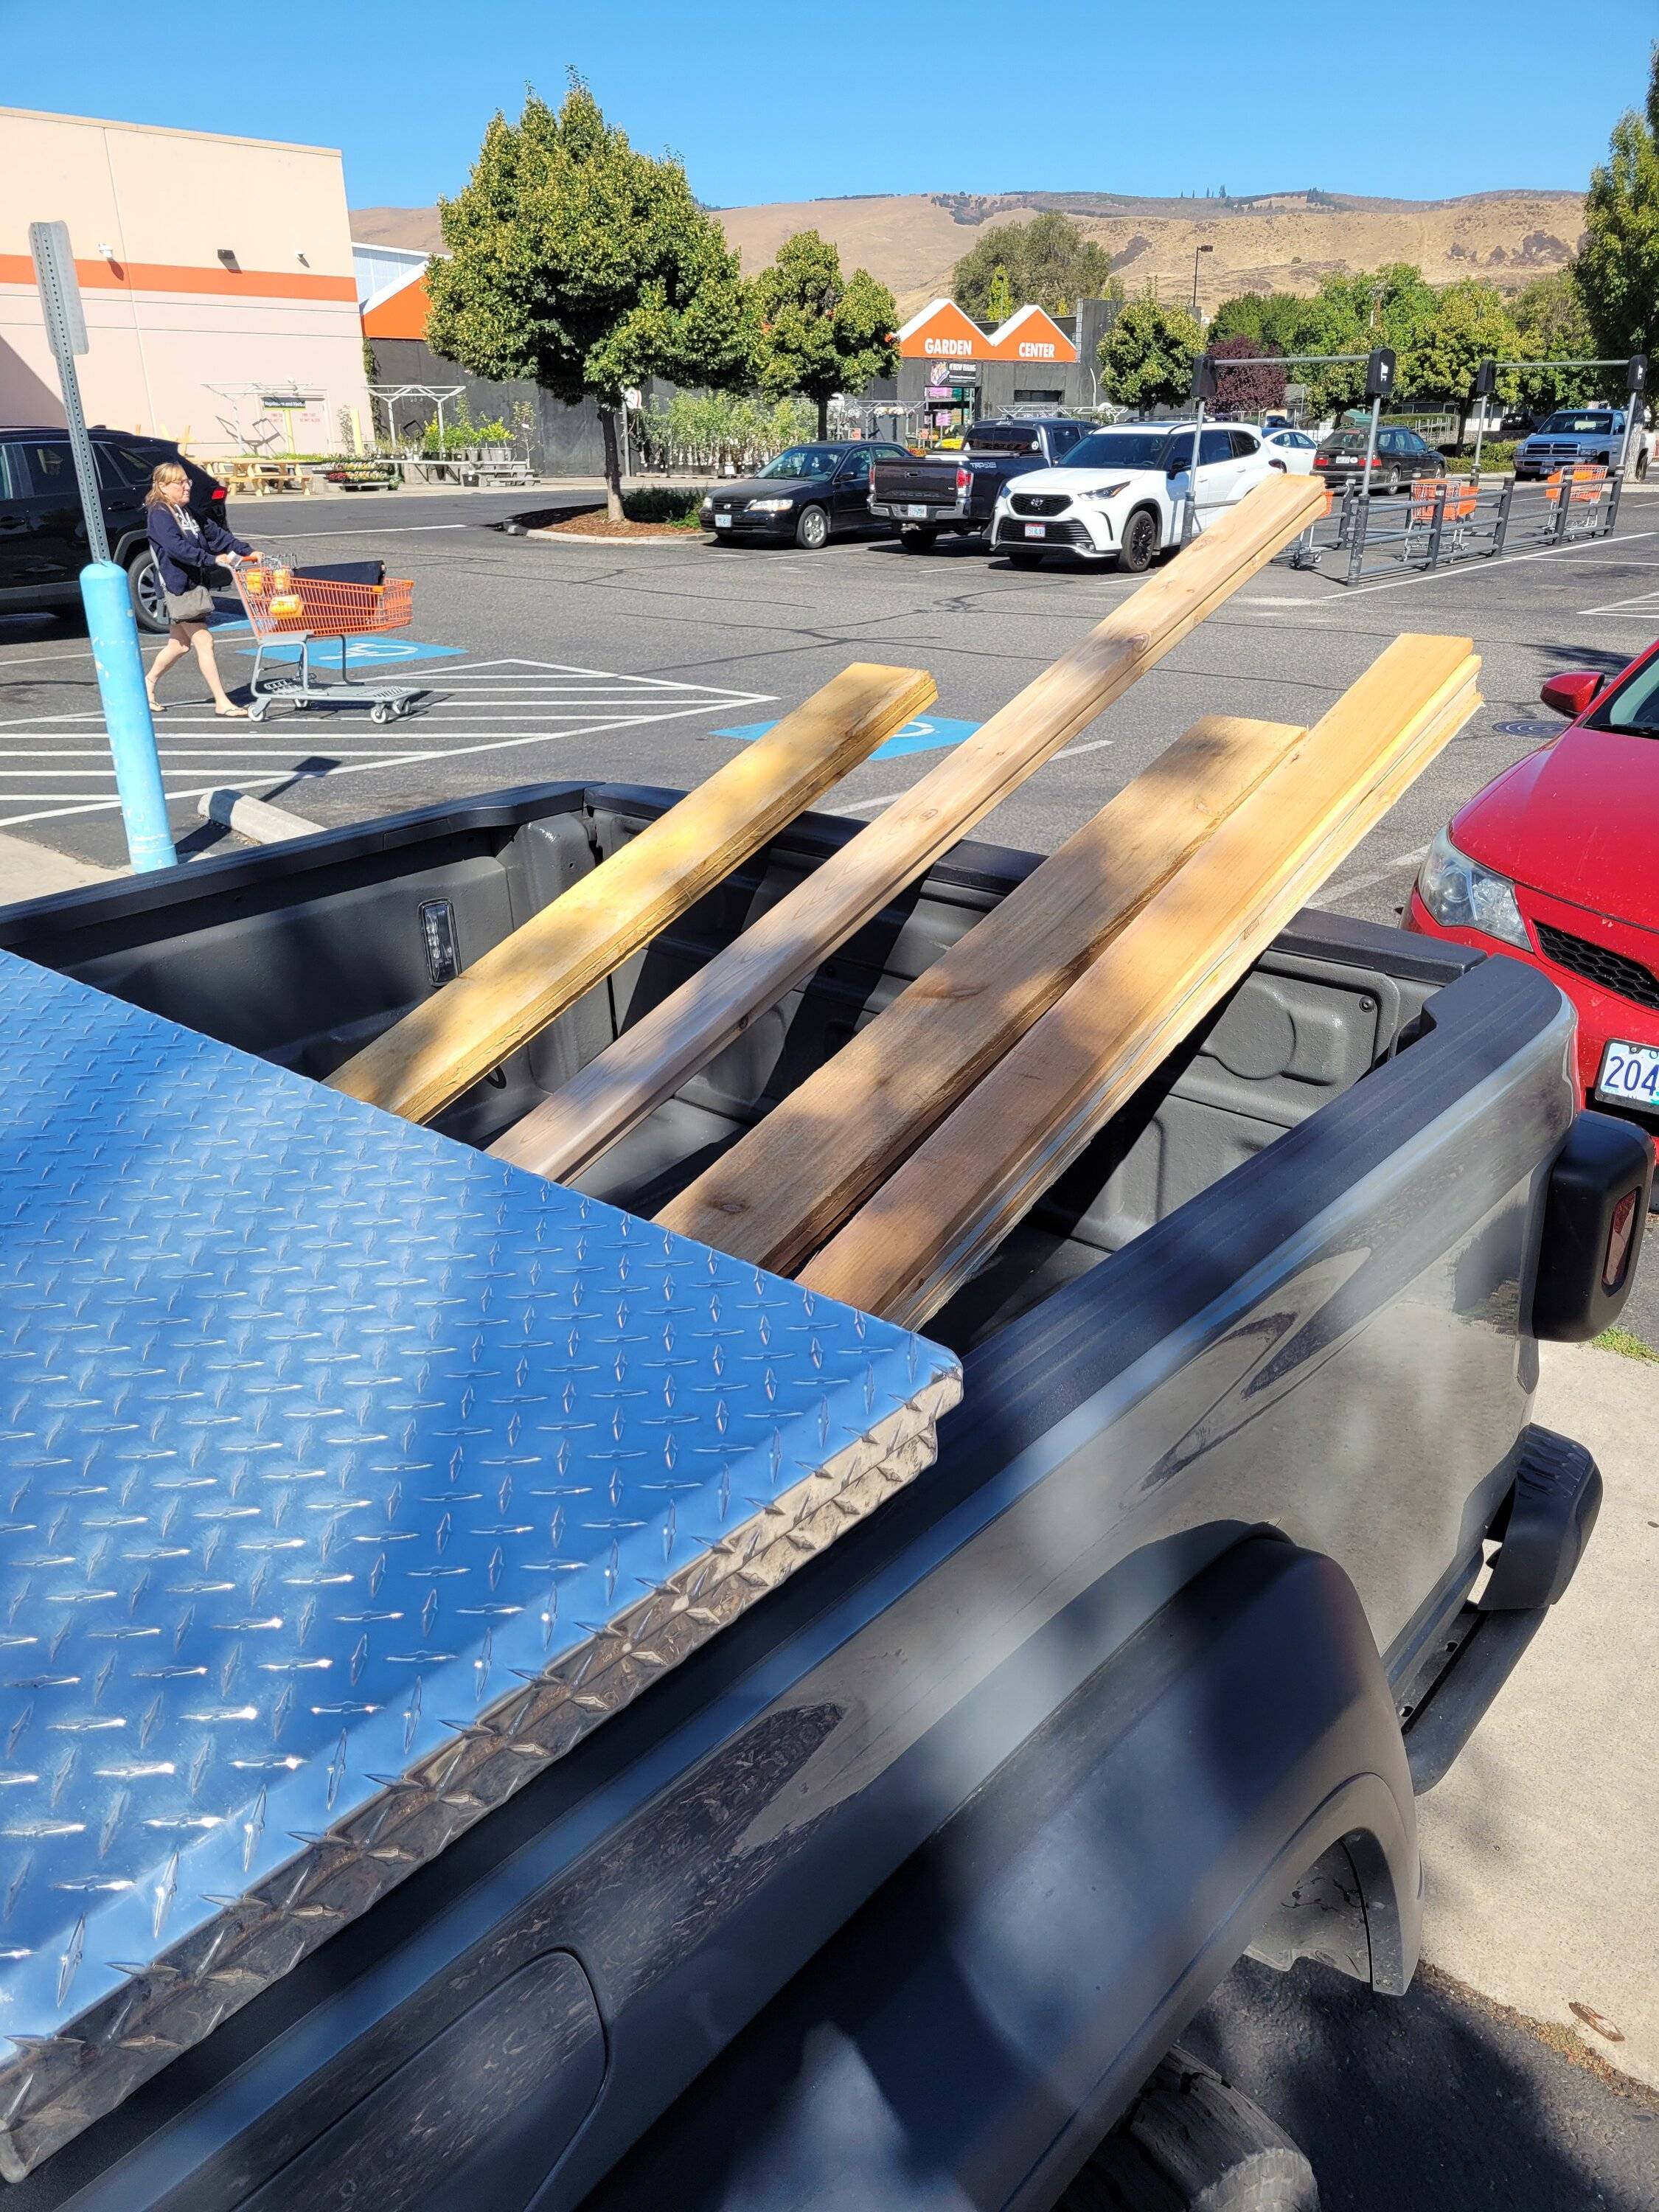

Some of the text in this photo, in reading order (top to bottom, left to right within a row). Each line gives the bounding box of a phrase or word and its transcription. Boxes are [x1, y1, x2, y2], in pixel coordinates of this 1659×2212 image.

[925, 338, 1055, 358] GARDEN CENTER
[1604, 1056, 1659, 1096] 204
